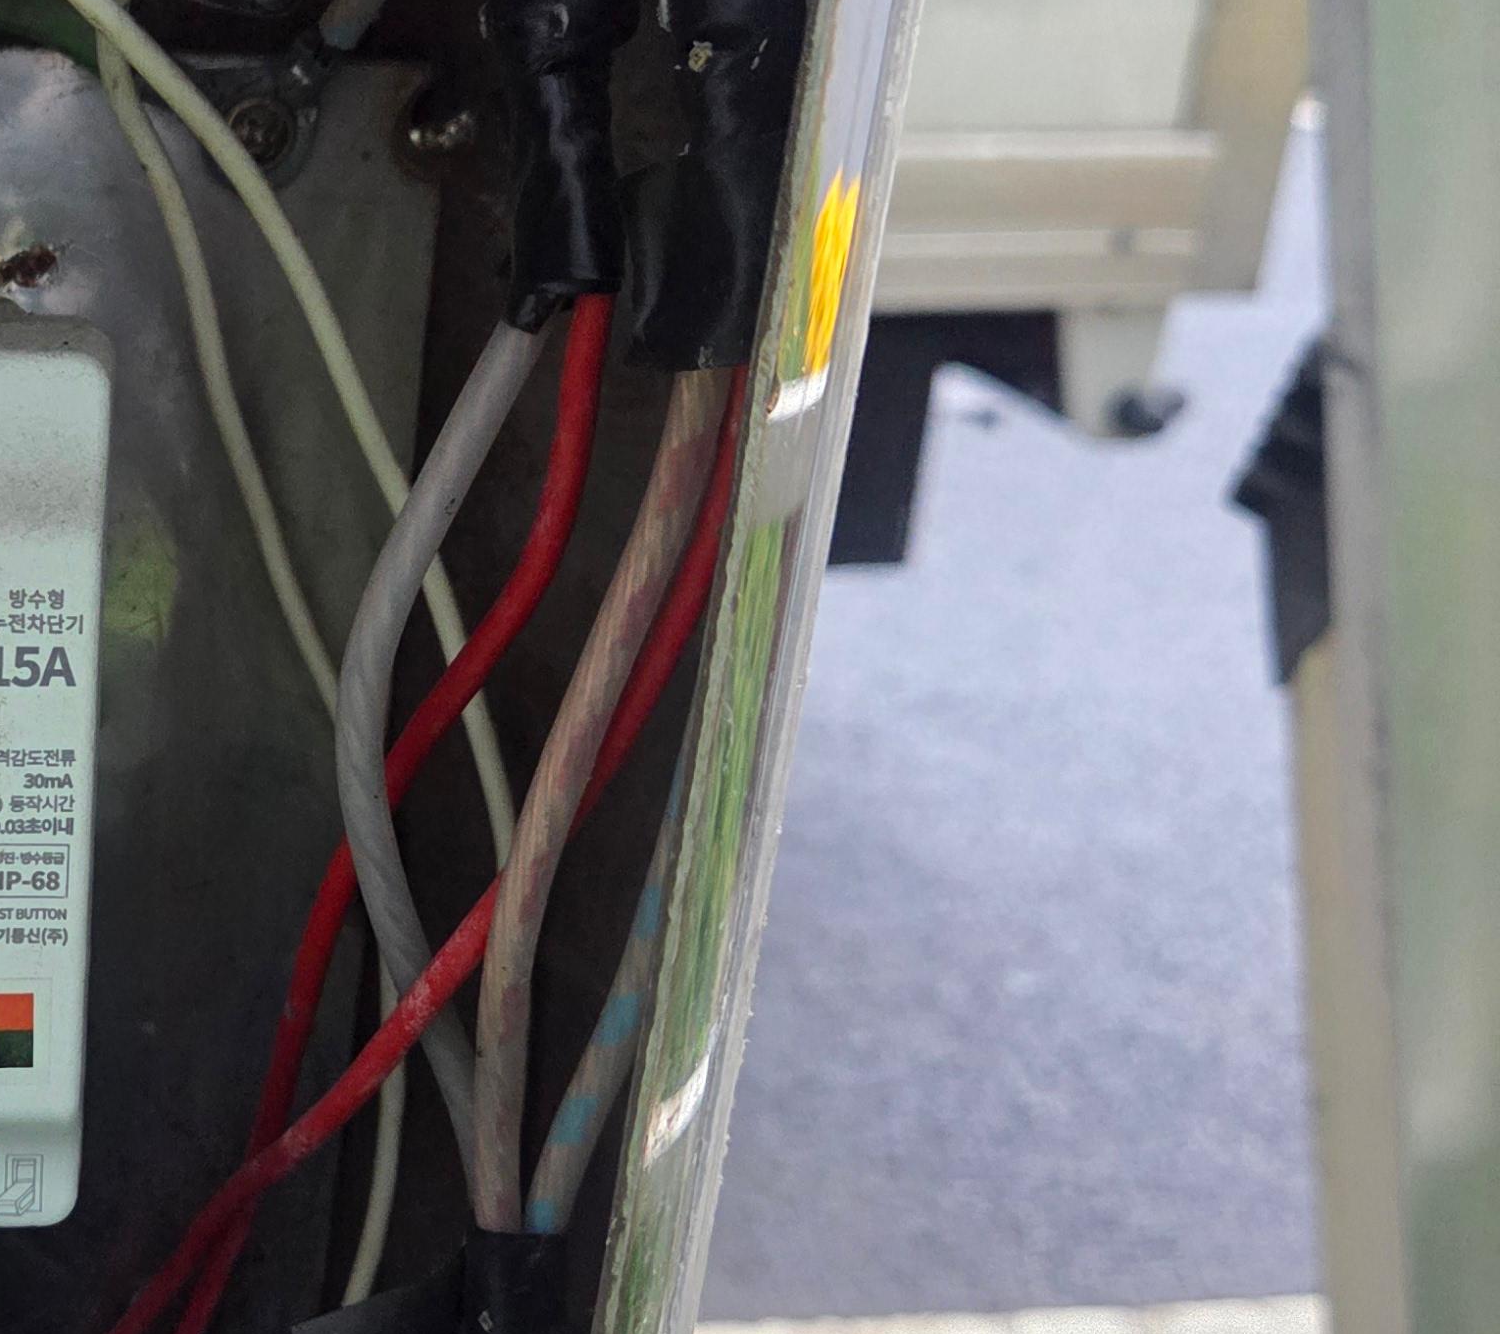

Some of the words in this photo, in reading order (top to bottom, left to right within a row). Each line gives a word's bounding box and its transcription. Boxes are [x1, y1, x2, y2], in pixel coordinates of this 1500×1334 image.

[9, 588, 65, 610] 방수형
[23, 773, 73, 788] 30mA
[9, 794, 75, 812] 동작시간
[16, 907, 66, 919] BUTTON
